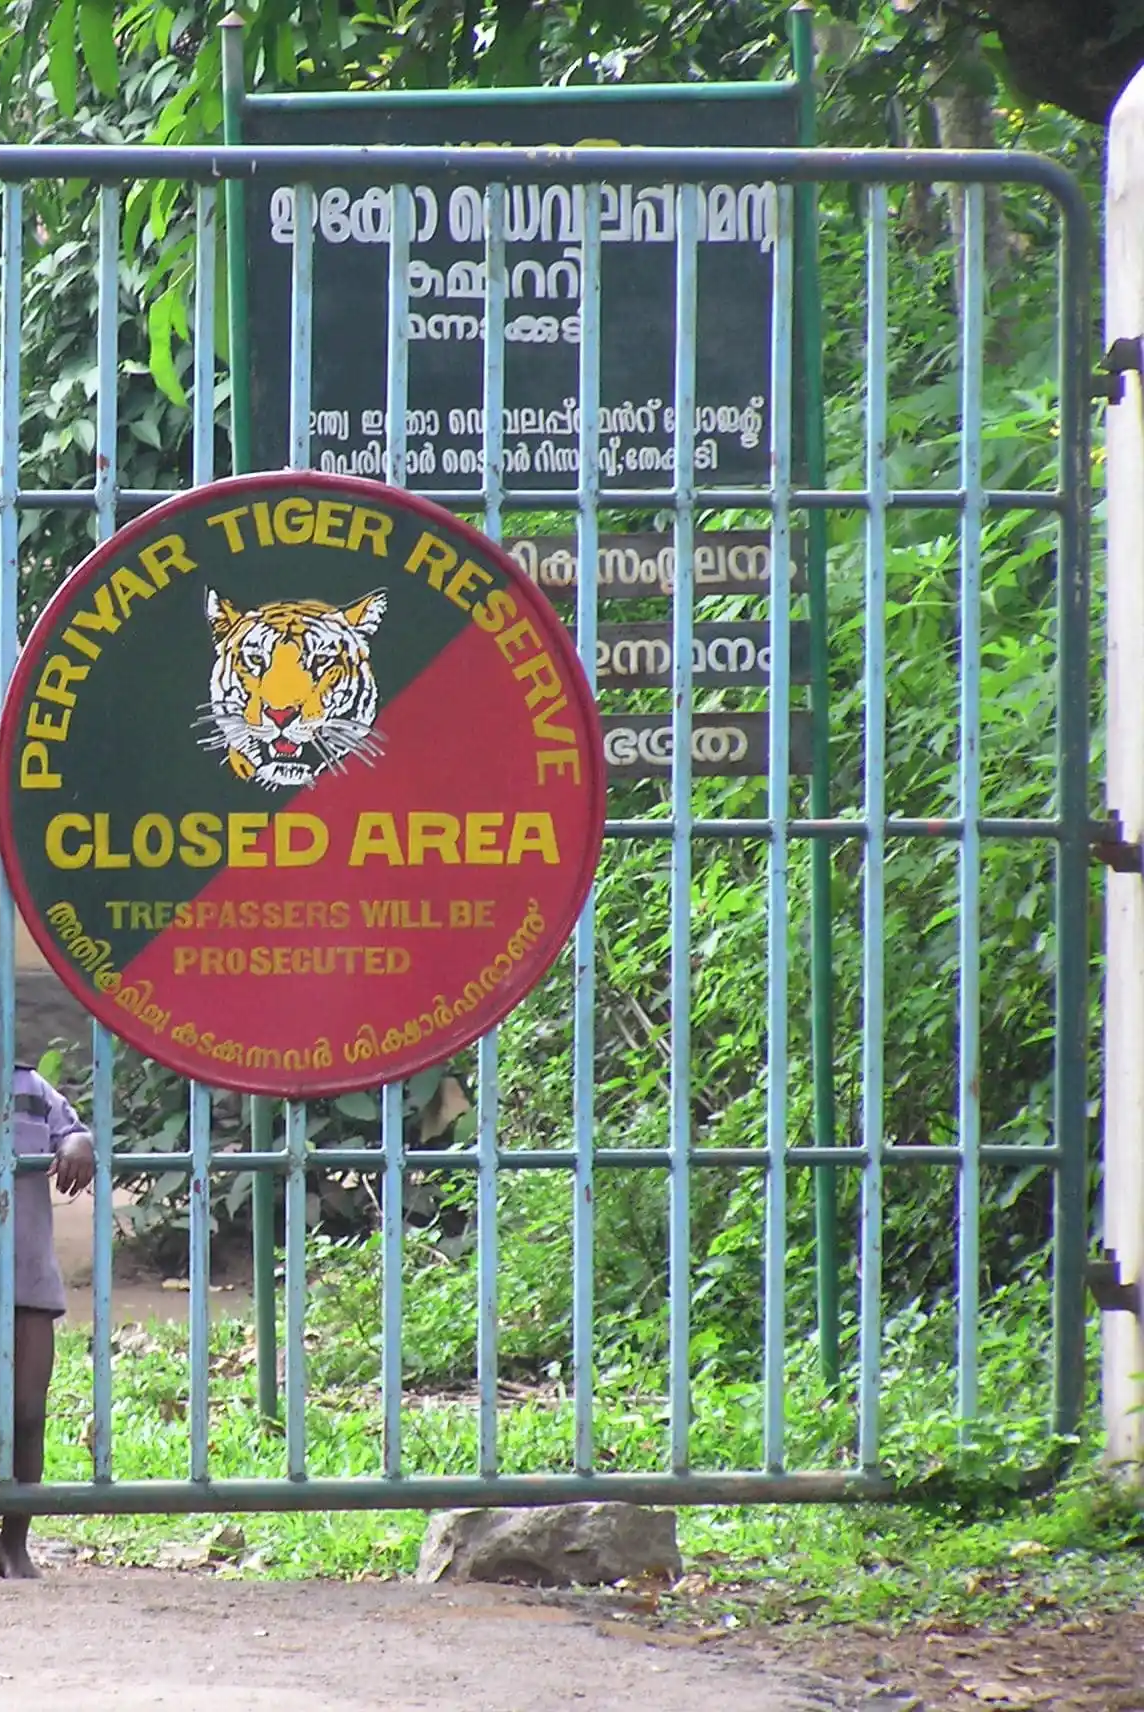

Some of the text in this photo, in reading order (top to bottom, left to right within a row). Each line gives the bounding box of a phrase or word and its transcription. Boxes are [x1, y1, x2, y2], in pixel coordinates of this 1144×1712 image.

[20, 496, 582, 790] PERIYAR TIGER RESERVE
[44, 811, 560, 870] CLOSED AREA
[104, 899, 496, 930] TRESPASSERS WILL BE
[173, 946, 412, 976] PROSECUTED
